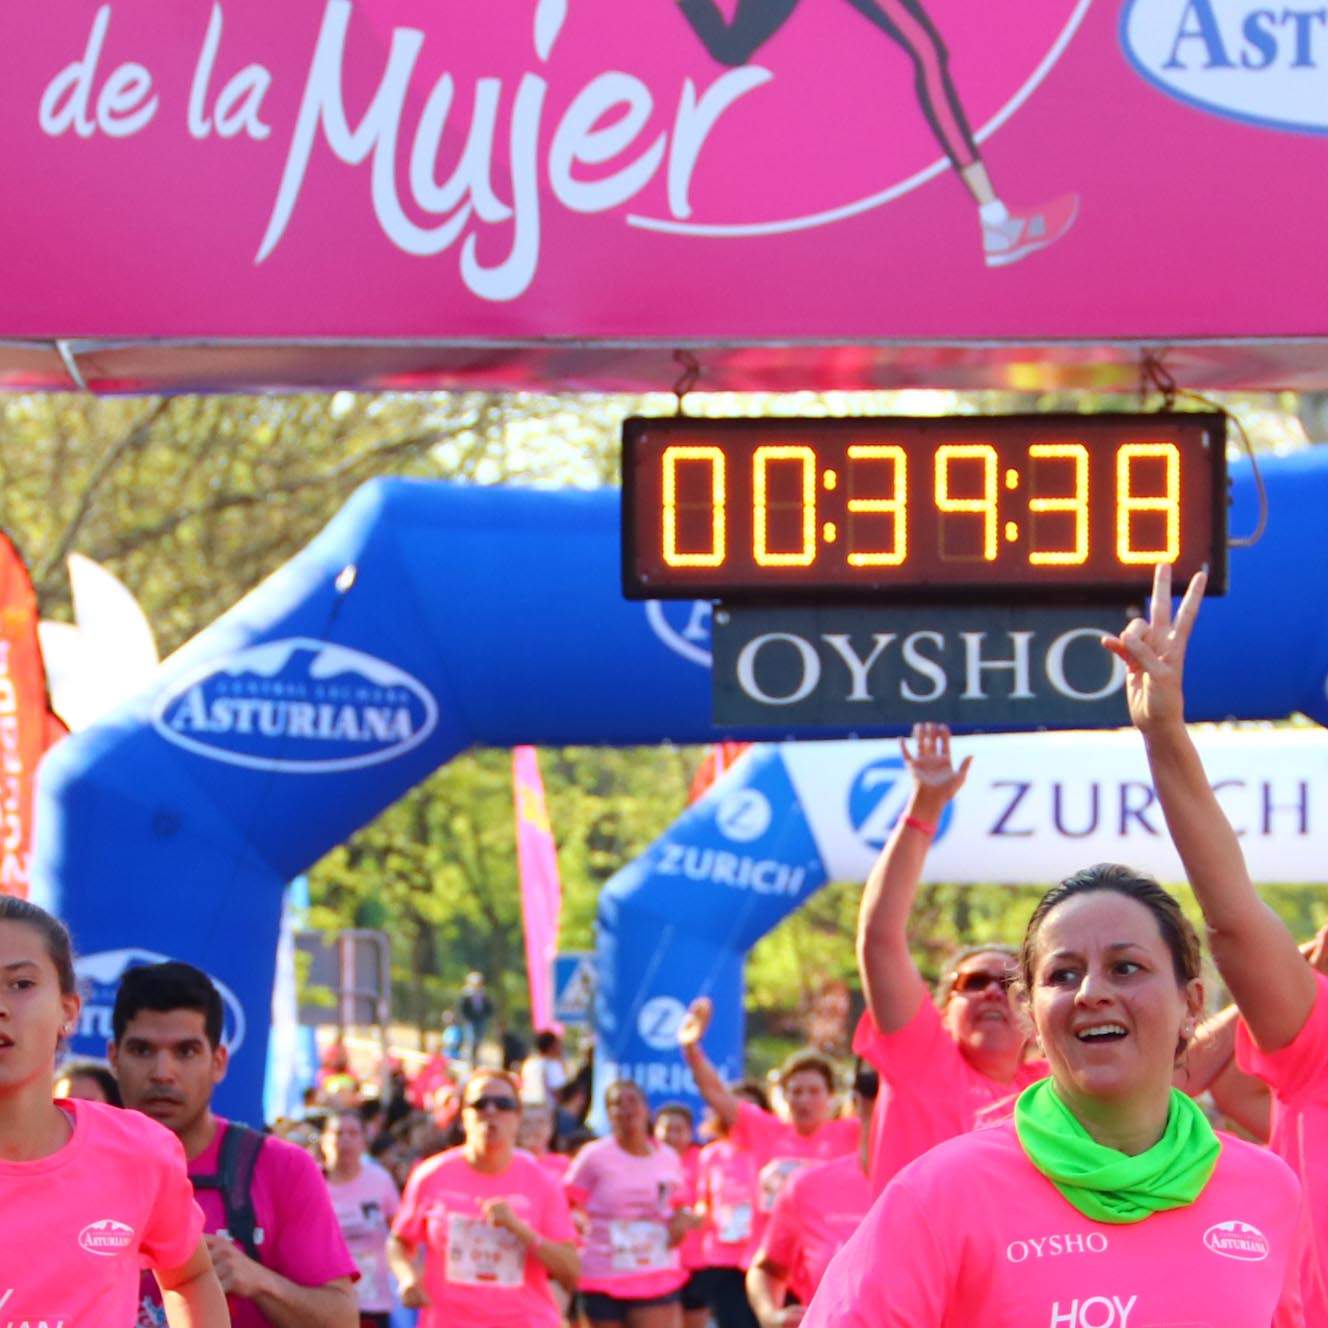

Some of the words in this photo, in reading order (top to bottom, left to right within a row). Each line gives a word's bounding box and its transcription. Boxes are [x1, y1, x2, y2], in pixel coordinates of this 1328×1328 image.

[38, 0, 159, 138] de
[187, 0, 274, 138] la
[255, 0, 775, 302] Mujer
[662, 443, 1180, 567] 00:39:38
[736, 628, 1128, 705] OYSHO
[171, 684, 415, 741] ASTURIANA
[988, 779, 1309, 837] ZURCH
[657, 844, 806, 897] ZURICH
[1006, 1232, 1109, 1263] OYSHO
